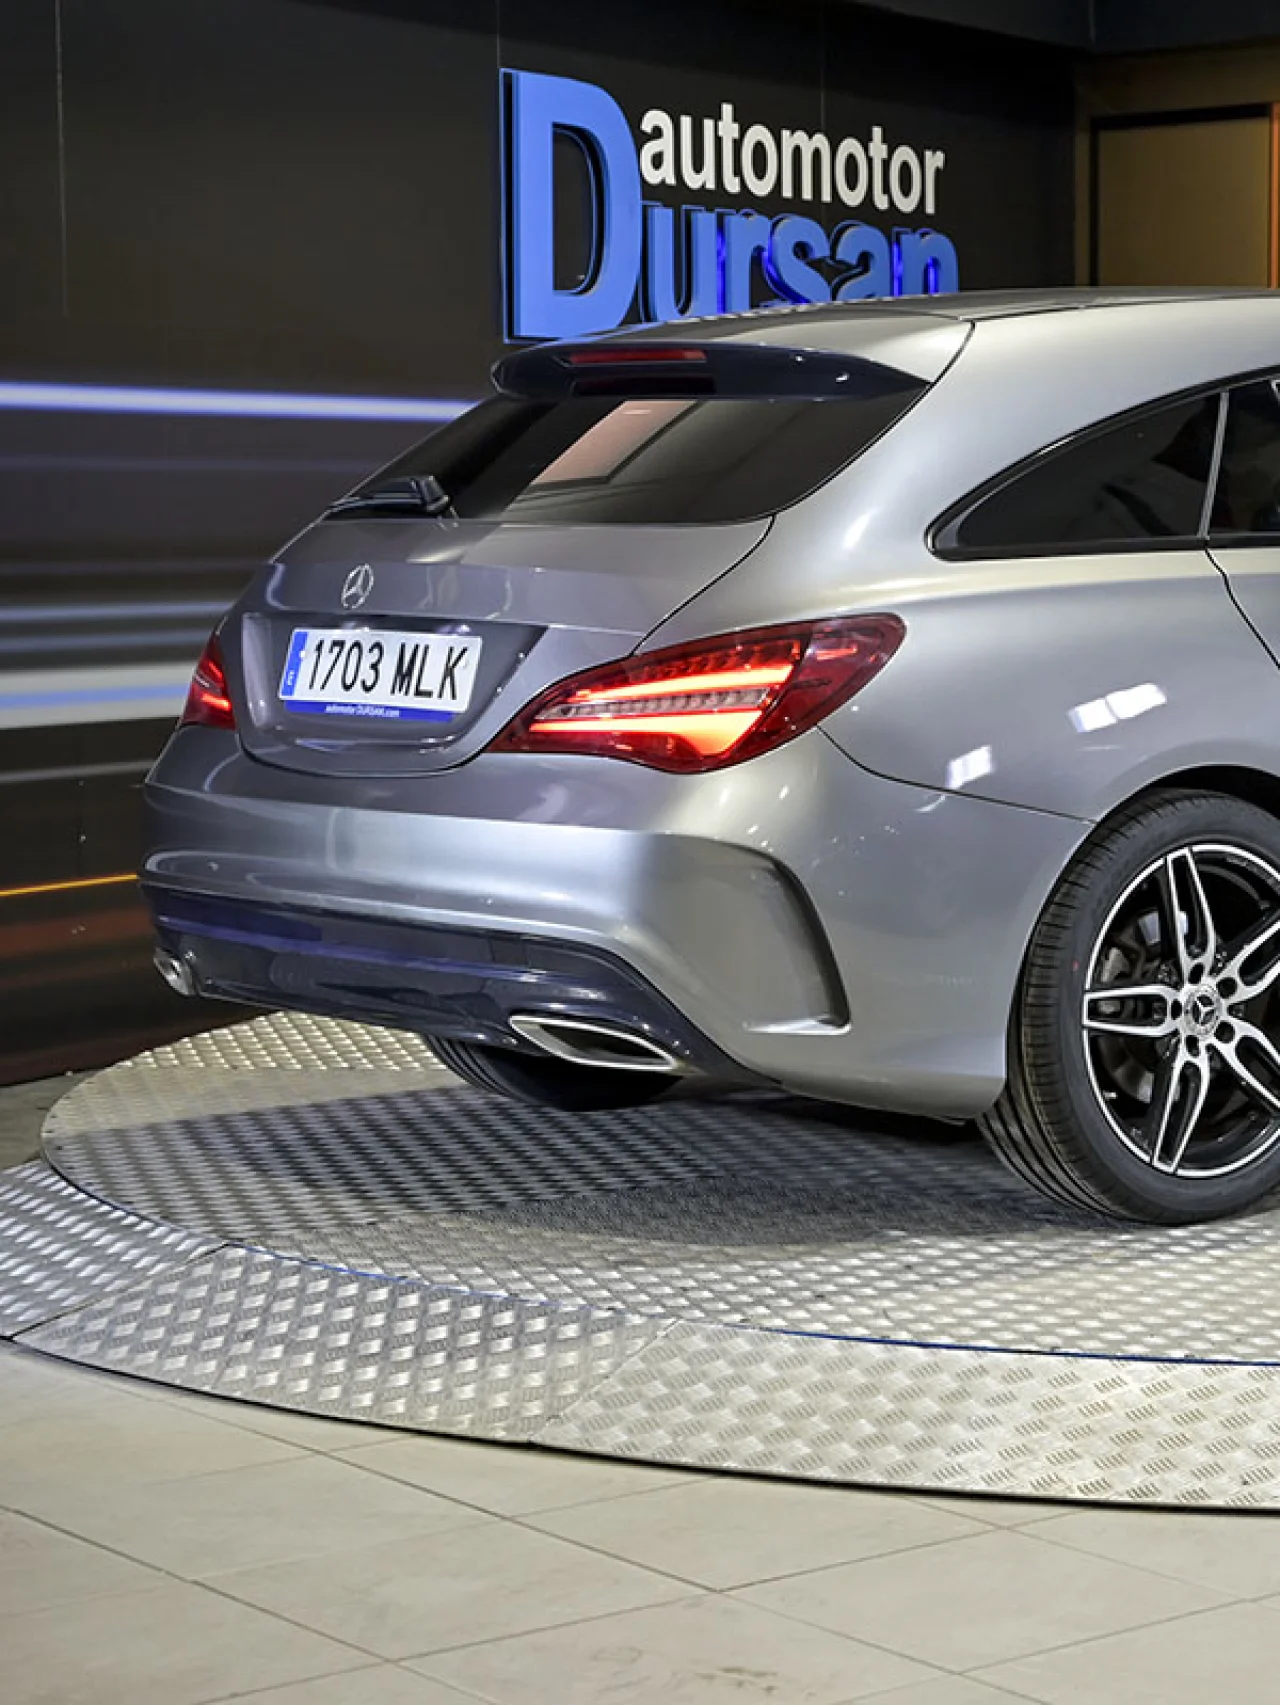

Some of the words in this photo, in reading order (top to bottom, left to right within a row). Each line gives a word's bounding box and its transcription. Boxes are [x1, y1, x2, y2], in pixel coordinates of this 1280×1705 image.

[499, 67, 959, 343] Dursan
[640, 102, 945, 214] automotor
[308, 639, 384, 694] 1703
[391, 642, 468, 701] MLK
